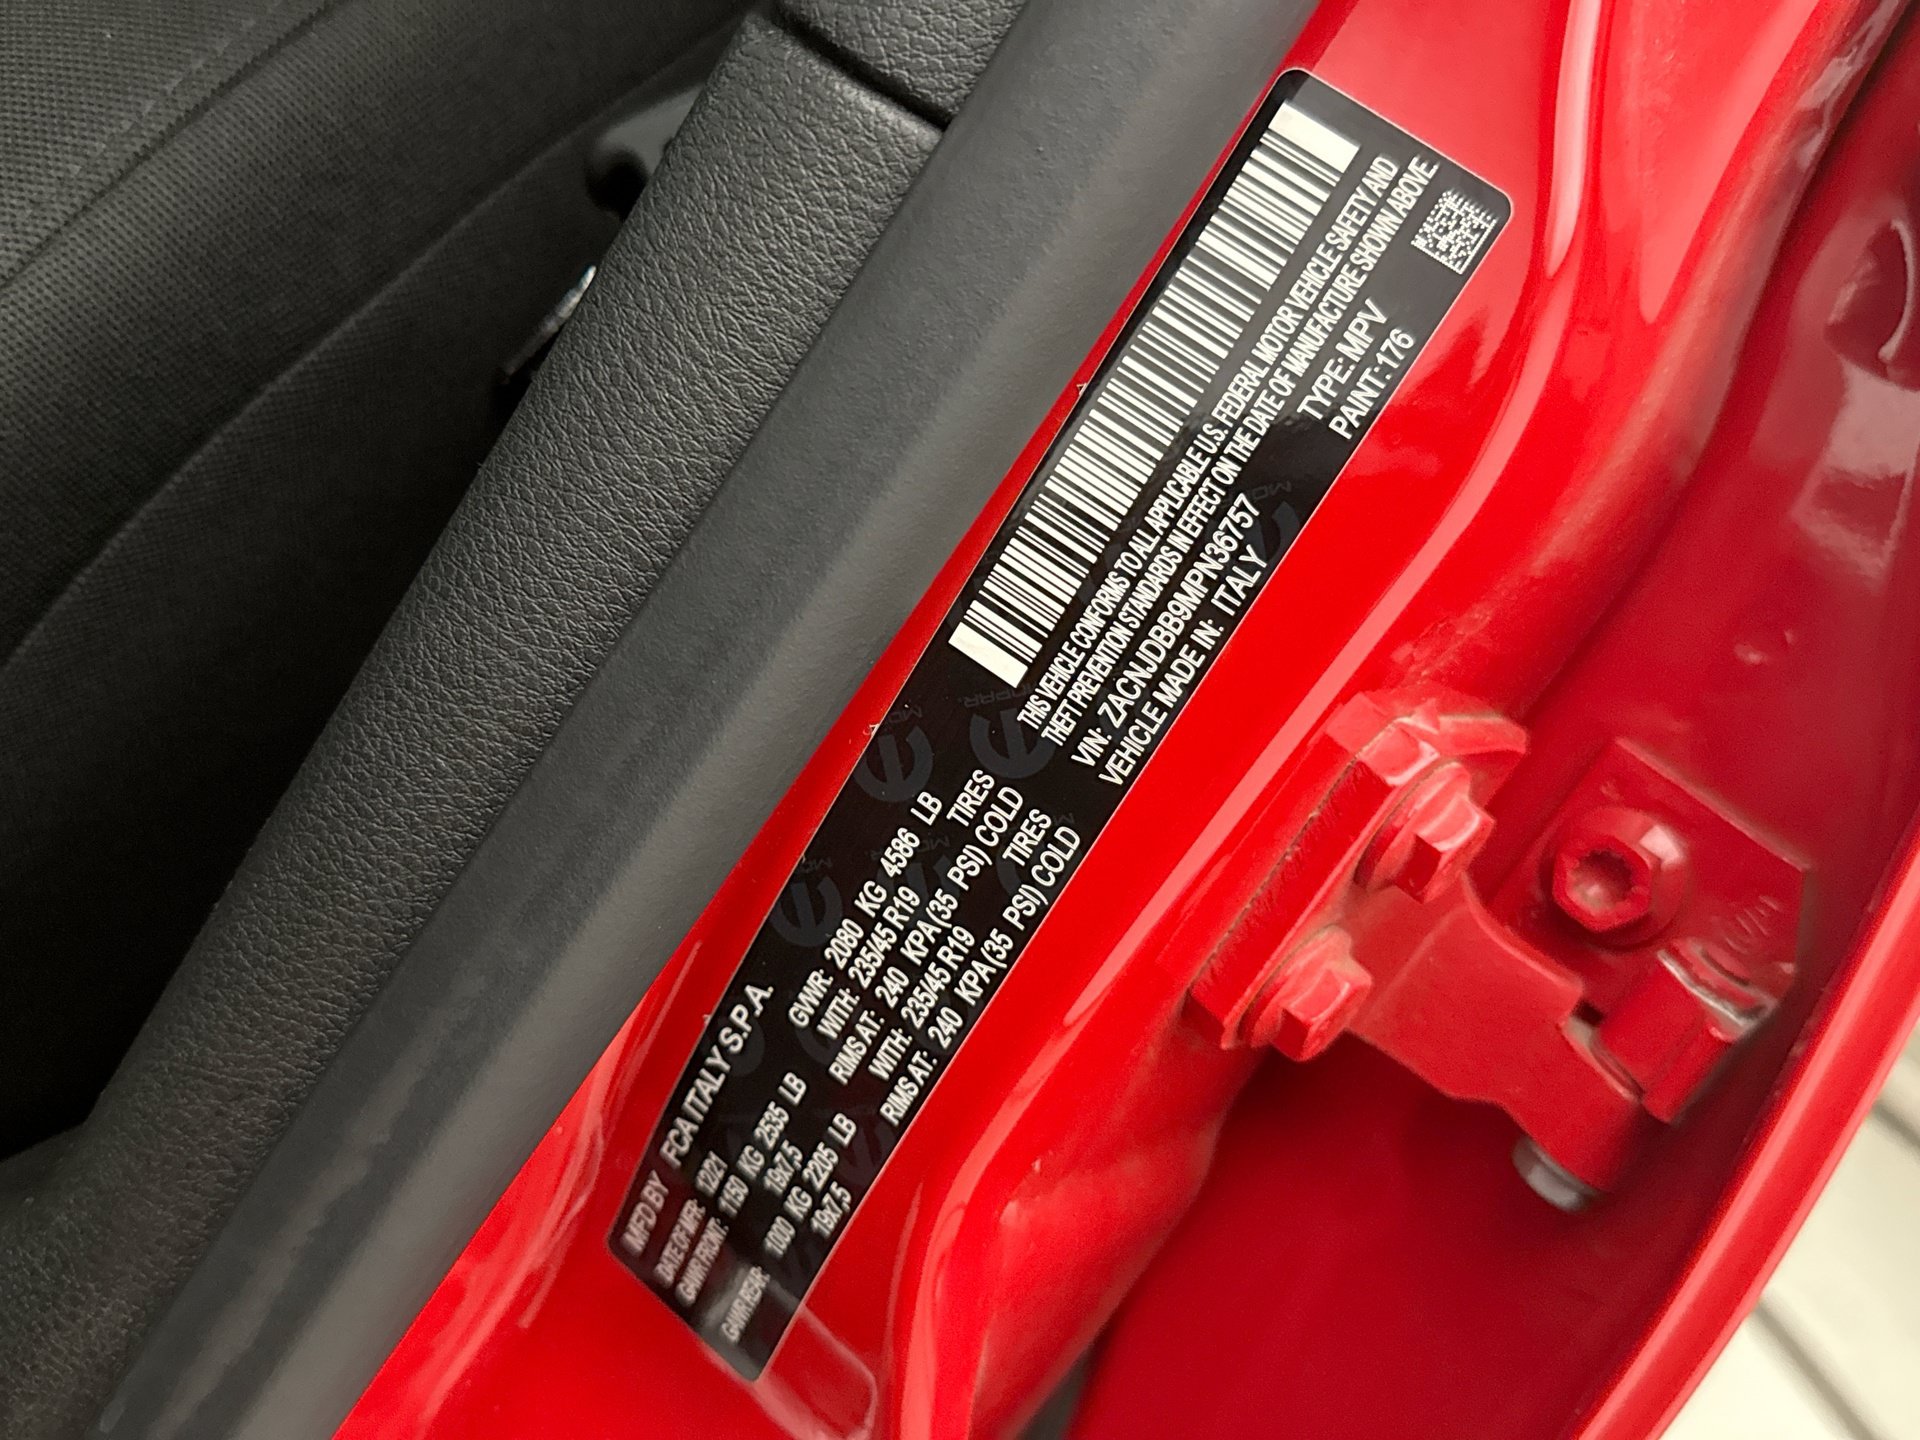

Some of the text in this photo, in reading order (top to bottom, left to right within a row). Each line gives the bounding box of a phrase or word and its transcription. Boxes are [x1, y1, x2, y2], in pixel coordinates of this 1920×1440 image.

[1361, 156, 1399, 198] AND
[1386, 156, 1439, 218] ABOVE.
[1325, 186, 1377, 251] SAFETY
[1349, 208, 1403, 271] SHOWN
[1284, 244, 1342, 311] VEHICLE
[1251, 305, 1304, 365] MOTOR
[1281, 263, 1367, 377] MANUFACTURE
[1211, 360, 1270, 428] FEDERAL
[1242, 389, 1285, 436] DATE
[1268, 367, 1296, 397] OF
[1193, 423, 1229, 454] U.S.
[1210, 455, 1242, 485] ON
[1223, 426, 1261, 463] THE
[1144, 446, 1211, 536] APPLICABLE
[1176, 477, 1226, 538] EFFECT
[1113, 551, 1143, 577] TO
[1128, 528, 1161, 561] ALL
[1166, 528, 1194, 554] IN
[1069, 571, 1131, 649] CONFORMS
[1118, 545, 1183, 629] STANDARDS
[1070, 493, 1259, 767] VIN: ZACNJDBB9MPN36757
[1034, 641, 1086, 701] VEHICLE
[1066, 621, 1134, 709] PREVENTION
[1098, 701, 1168, 785] VEHICLE
[1152, 643, 1206, 708] MADE
[1190, 619, 1224, 650] IN:
[1210, 544, 1267, 616] ITALY
[1016, 694, 1052, 730] THIS
[1040, 698, 1083, 746] THEFT
[788, 969, 834, 1027] GVWR:
[824, 918, 864, 970] 2080
[854, 880, 887, 918] KG
[880, 827, 920, 878] 4586
[910, 791, 943, 826] LB
[817, 988, 860, 1039] WITH:
[848, 922, 897, 989] 235/45
[882, 886, 920, 931] R19
[946, 769, 995, 827] TIRES
[829, 1036, 867, 1084] RIMS
[855, 1010, 885, 1045] AT:
[874, 966, 910, 1008] 240
[946, 844, 993, 891] PSI)
[974, 786, 1024, 847] COLD
[868, 808, 1052, 1080] WITH: 235/45 R19 TIRES
[880, 1076, 919, 1125] RIMS
[907, 1050, 938, 1086] AT:
[927, 1006, 963, 1049] 240
[1002, 884, 1049, 931] PSI)
[1031, 826, 1081, 887] COLD
[624, 985, 774, 1252] MFD BY FCA ITALY S.P.A.
[655, 1151, 728, 1283] DATE OF MFR: 12/21
[678, 1072, 807, 1302] GAWR FRONT: 1150 KG 2535 LB
[721, 1113, 857, 1342] GAWR REAR: 1000 KG 2205 LB
